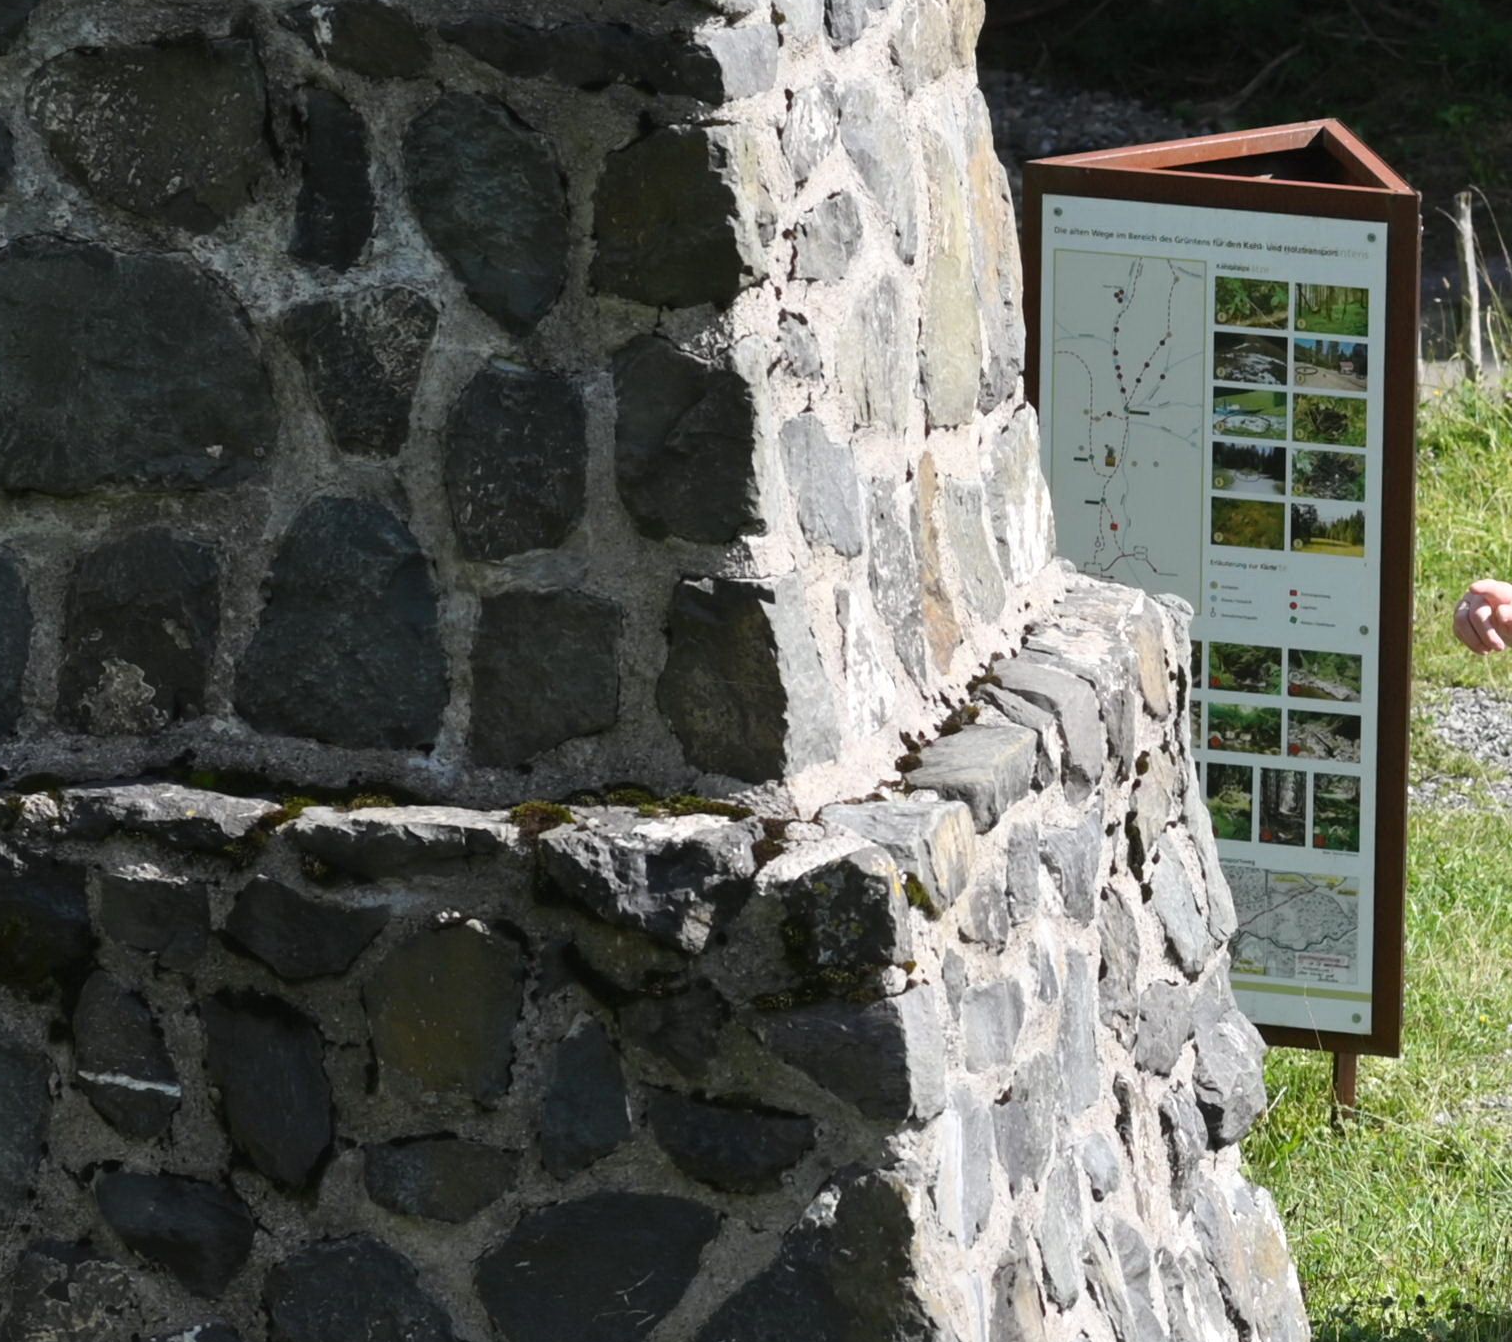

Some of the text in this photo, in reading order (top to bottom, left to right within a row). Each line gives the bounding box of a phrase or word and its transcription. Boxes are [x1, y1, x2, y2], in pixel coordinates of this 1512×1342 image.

[1054, 226, 1067, 235] Die
[1069, 227, 1090, 236] alten
[1091, 229, 1114, 239] Wege
[1128, 232, 1157, 242] Bereich
[1159, 234, 1173, 244] des
